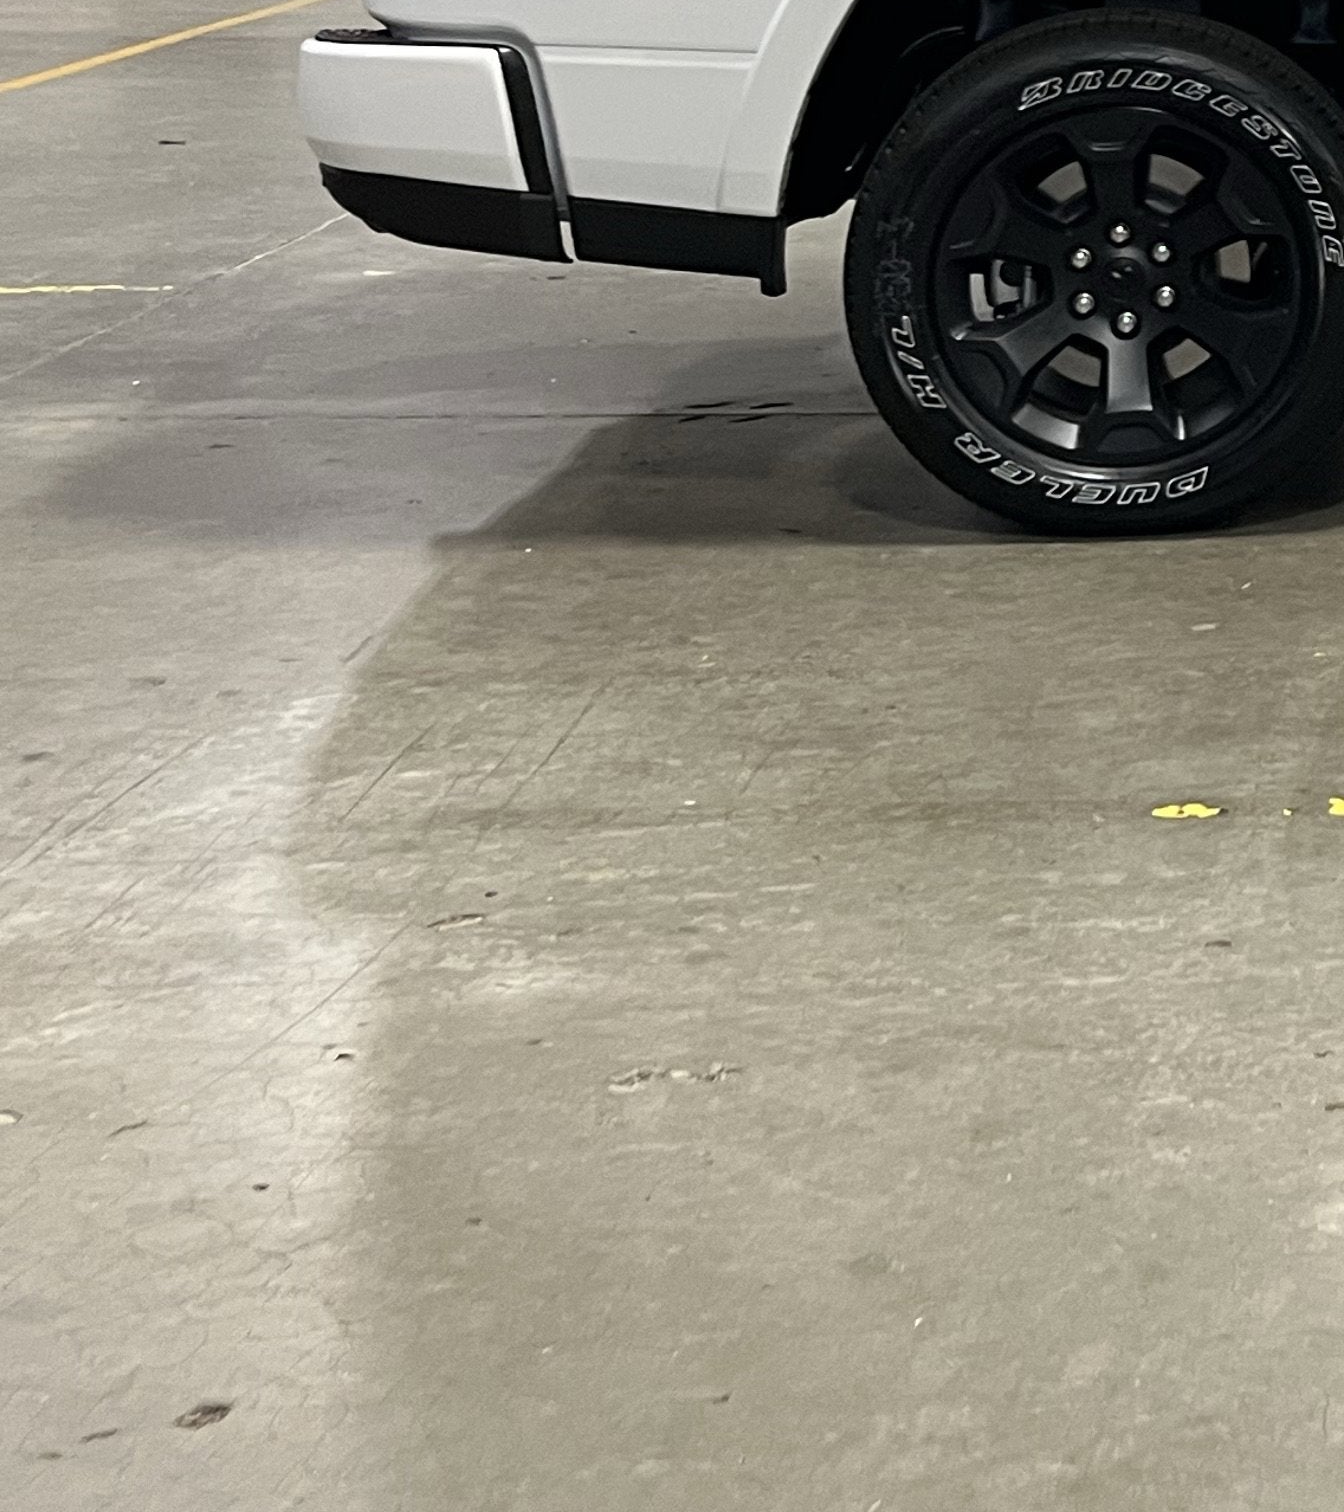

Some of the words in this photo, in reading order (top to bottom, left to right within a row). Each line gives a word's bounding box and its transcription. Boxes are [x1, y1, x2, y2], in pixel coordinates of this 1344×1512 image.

[1018, 68, 1344, 267] BRIDGESTONE
[890, 315, 947, 409] H/L
[954, 432, 1209, 505] DUELER
